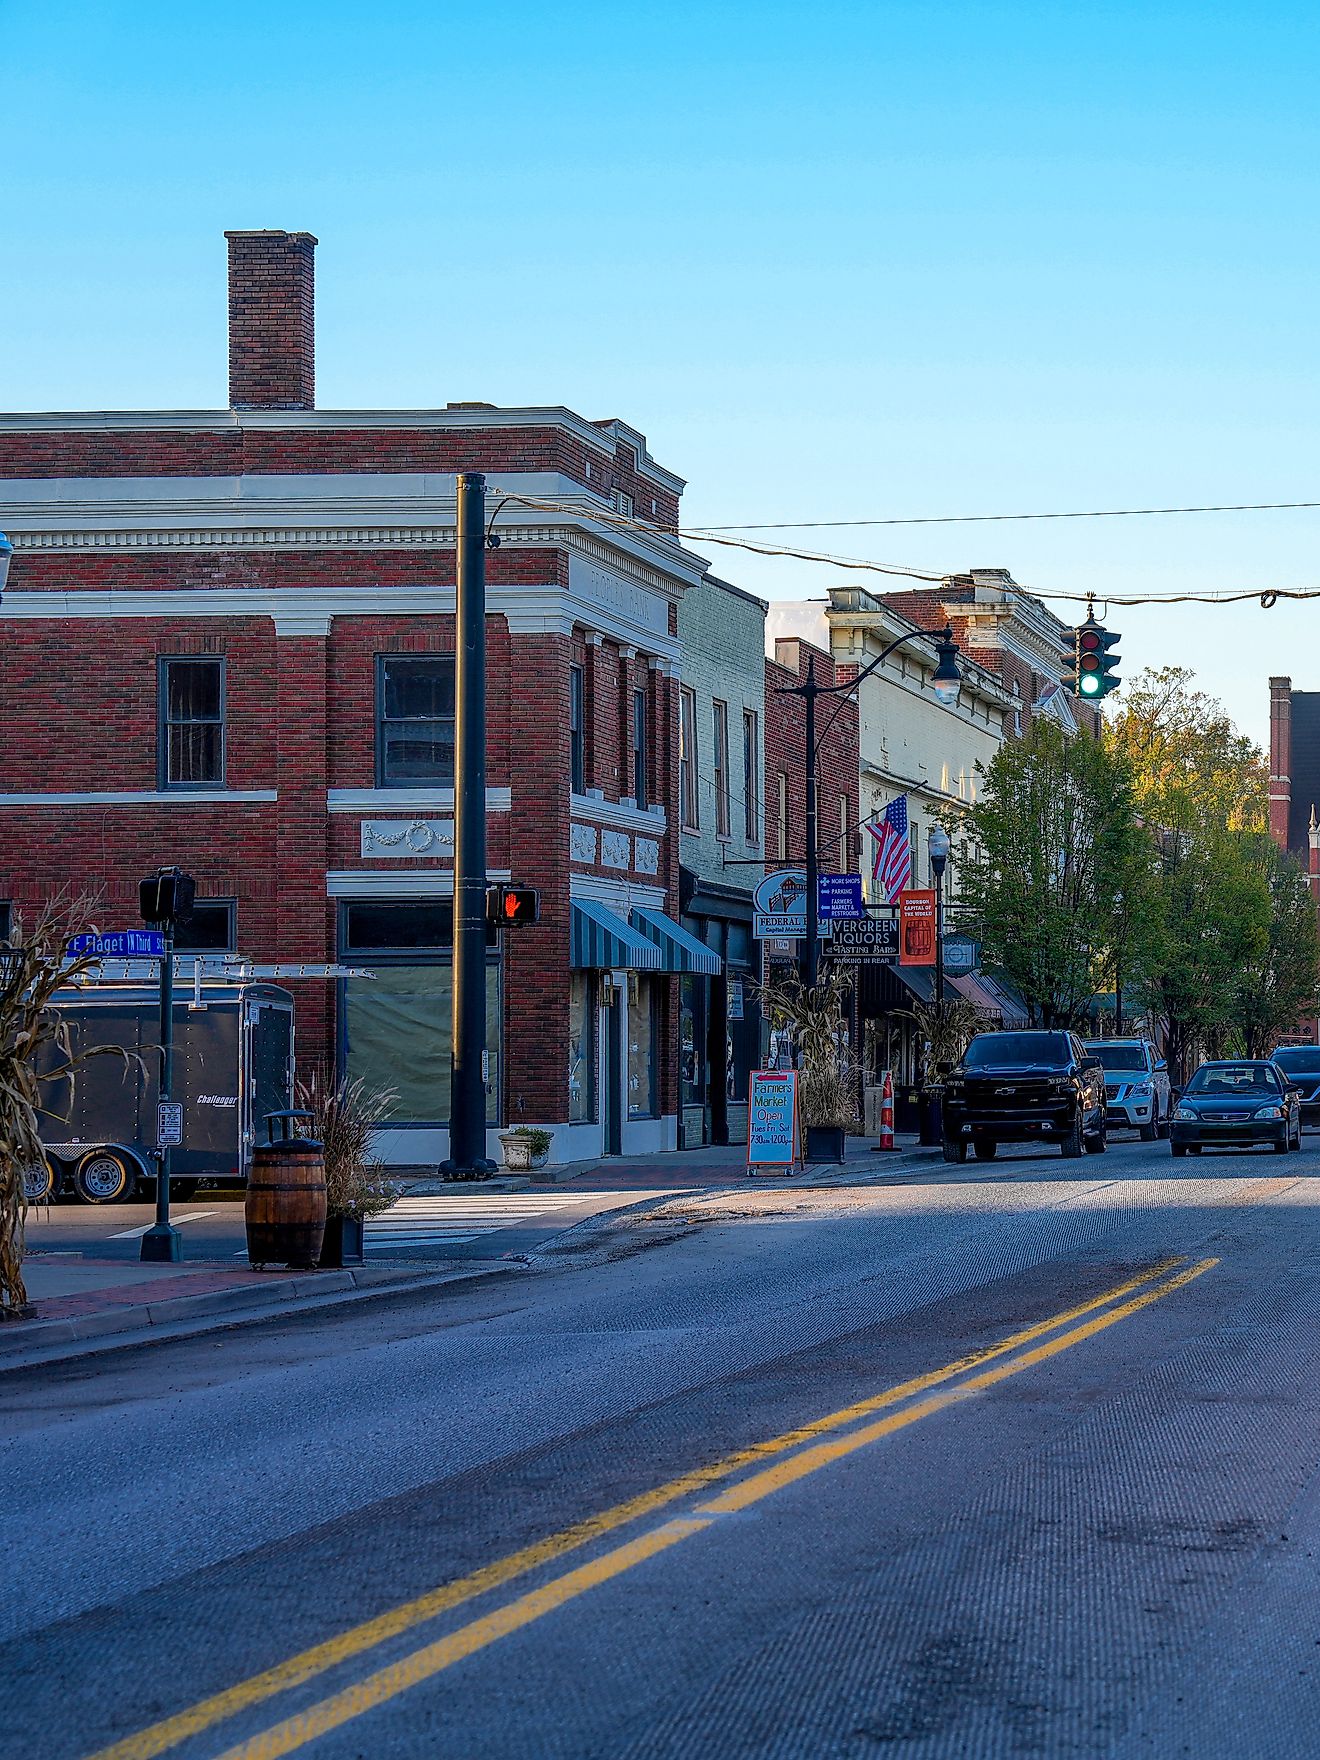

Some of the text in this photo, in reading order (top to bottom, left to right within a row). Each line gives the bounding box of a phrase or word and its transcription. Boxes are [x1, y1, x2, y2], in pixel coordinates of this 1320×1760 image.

[760, 917, 801, 926] FEDERAL
[833, 920, 897, 932] VERGREEN
[136, 933, 151, 952] Third
[833, 932, 890, 945] LIQUORS
[85, 935, 124, 955] Flaget
[754, 1082, 792, 1094] Farmers
[196, 1094, 237, 1105] Challenger
[754, 1095, 788, 1107] Market
[757, 1109, 783, 1123] Open
[750, 1122, 790, 1132] Tues Fri Sat
